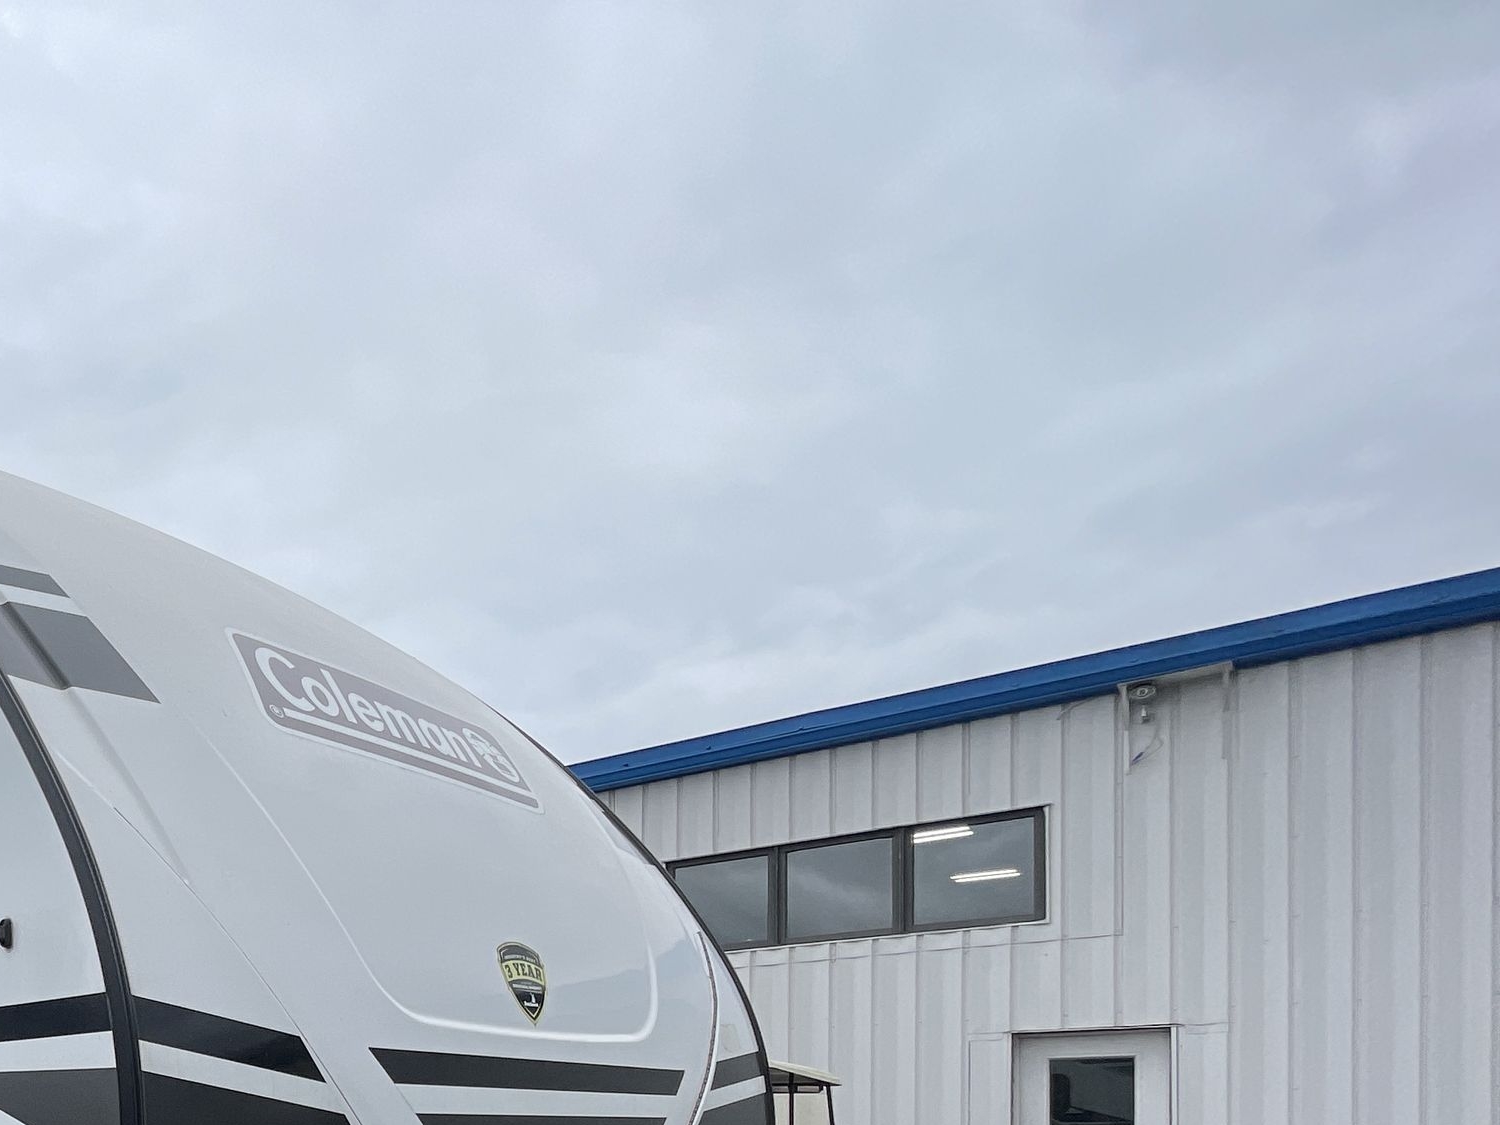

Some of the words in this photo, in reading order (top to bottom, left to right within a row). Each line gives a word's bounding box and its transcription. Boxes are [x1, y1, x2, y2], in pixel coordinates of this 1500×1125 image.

[254, 646, 483, 769] Coleman
[504, 964, 514, 979] 3
[512, 962, 544, 983] YEAR
